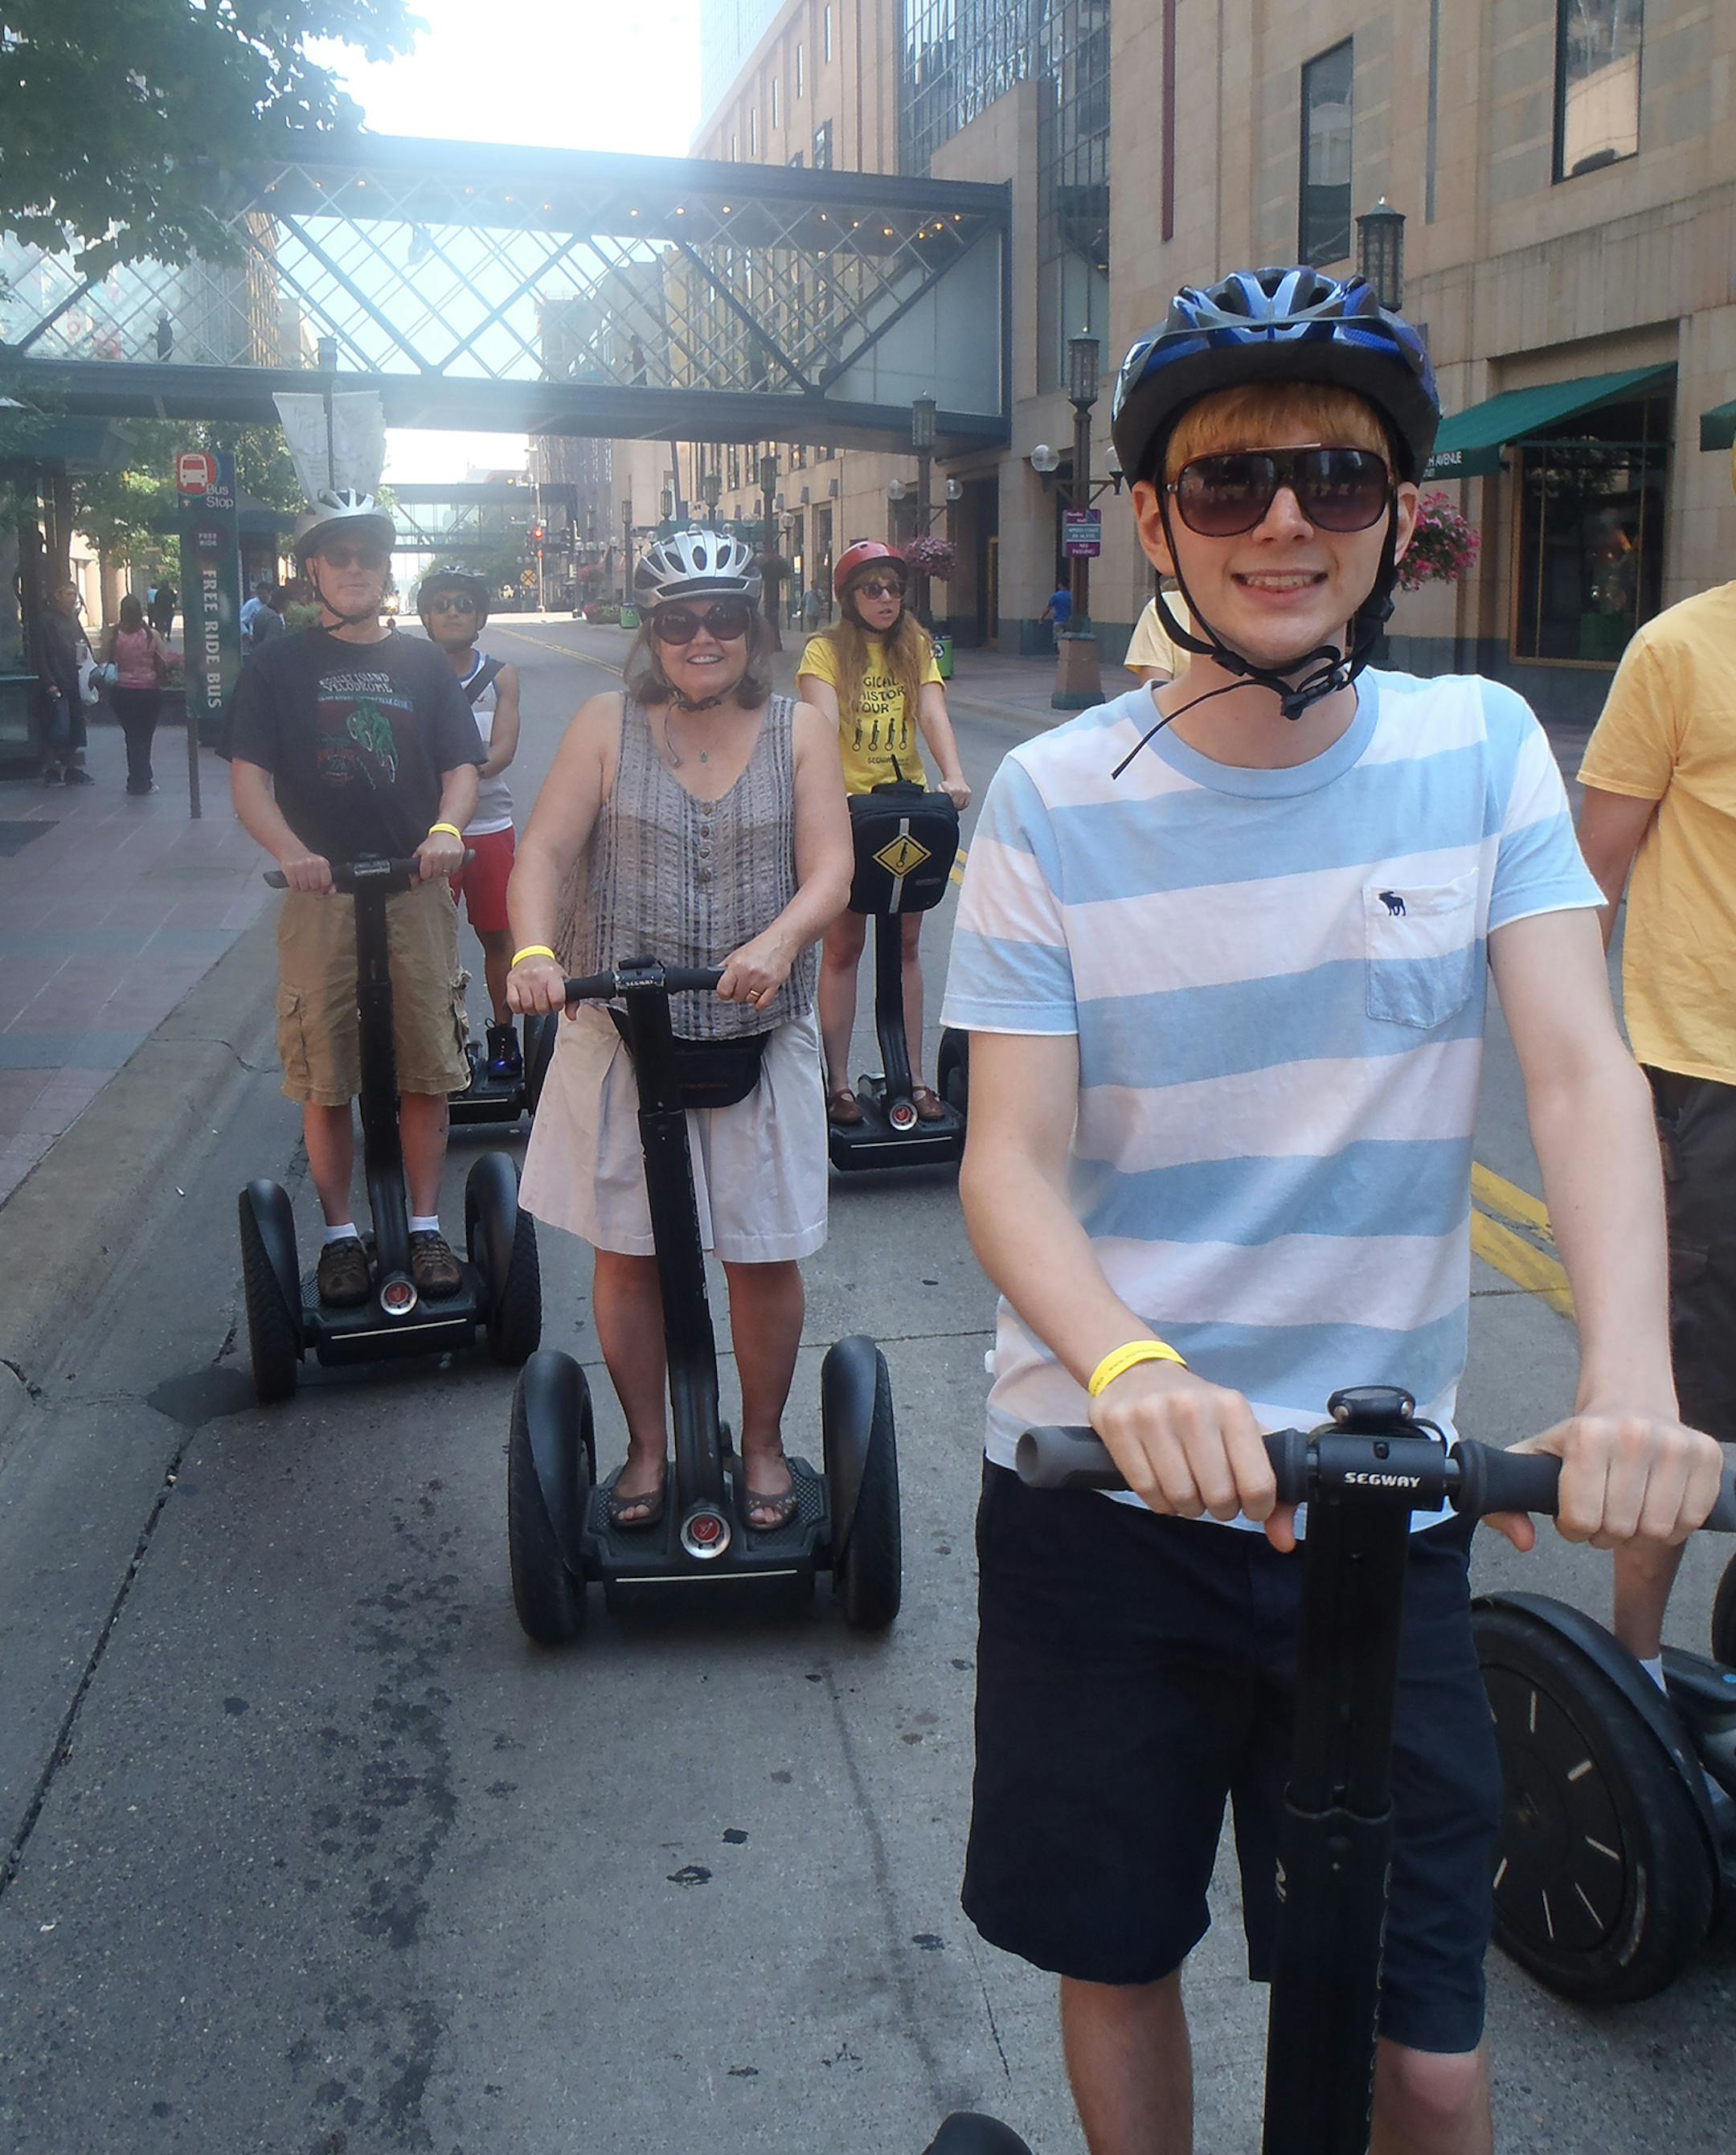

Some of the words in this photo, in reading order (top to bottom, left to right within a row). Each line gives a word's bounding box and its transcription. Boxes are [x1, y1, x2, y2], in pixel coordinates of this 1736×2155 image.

[207, 484, 229, 495] Bus
[206, 495, 234, 510] Stop
[203, 570, 218, 612] FREE
[205, 621, 221, 664] RIDE
[207, 673, 222, 709] BUS
[860, 702, 889, 714] OUR
[1344, 1472, 1420, 1488] SEGWAY
